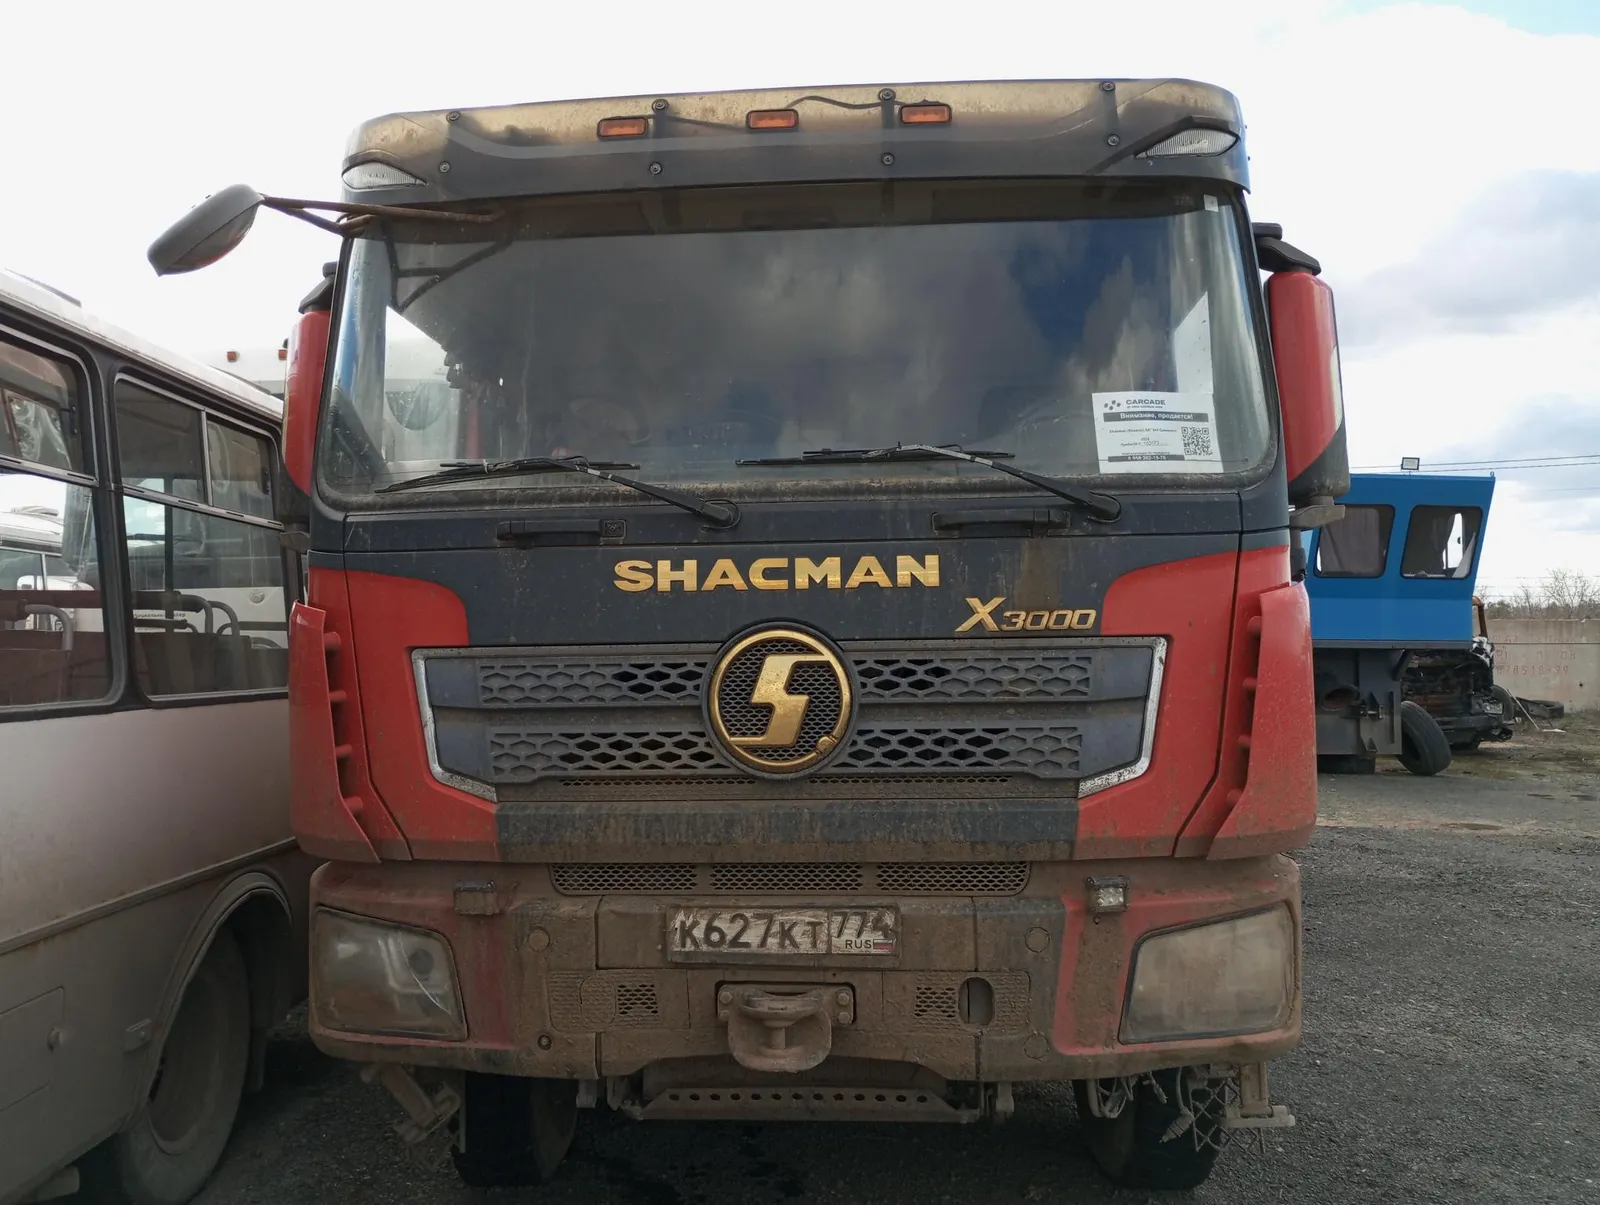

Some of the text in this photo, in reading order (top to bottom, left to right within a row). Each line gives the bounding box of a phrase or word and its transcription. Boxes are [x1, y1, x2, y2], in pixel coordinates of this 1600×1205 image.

[1126, 398, 1166, 406] CARCADE
[613, 554, 940, 593] SHACMAN
[954, 596, 1097, 633] X3000
[845, 939, 872, 950] RUS
